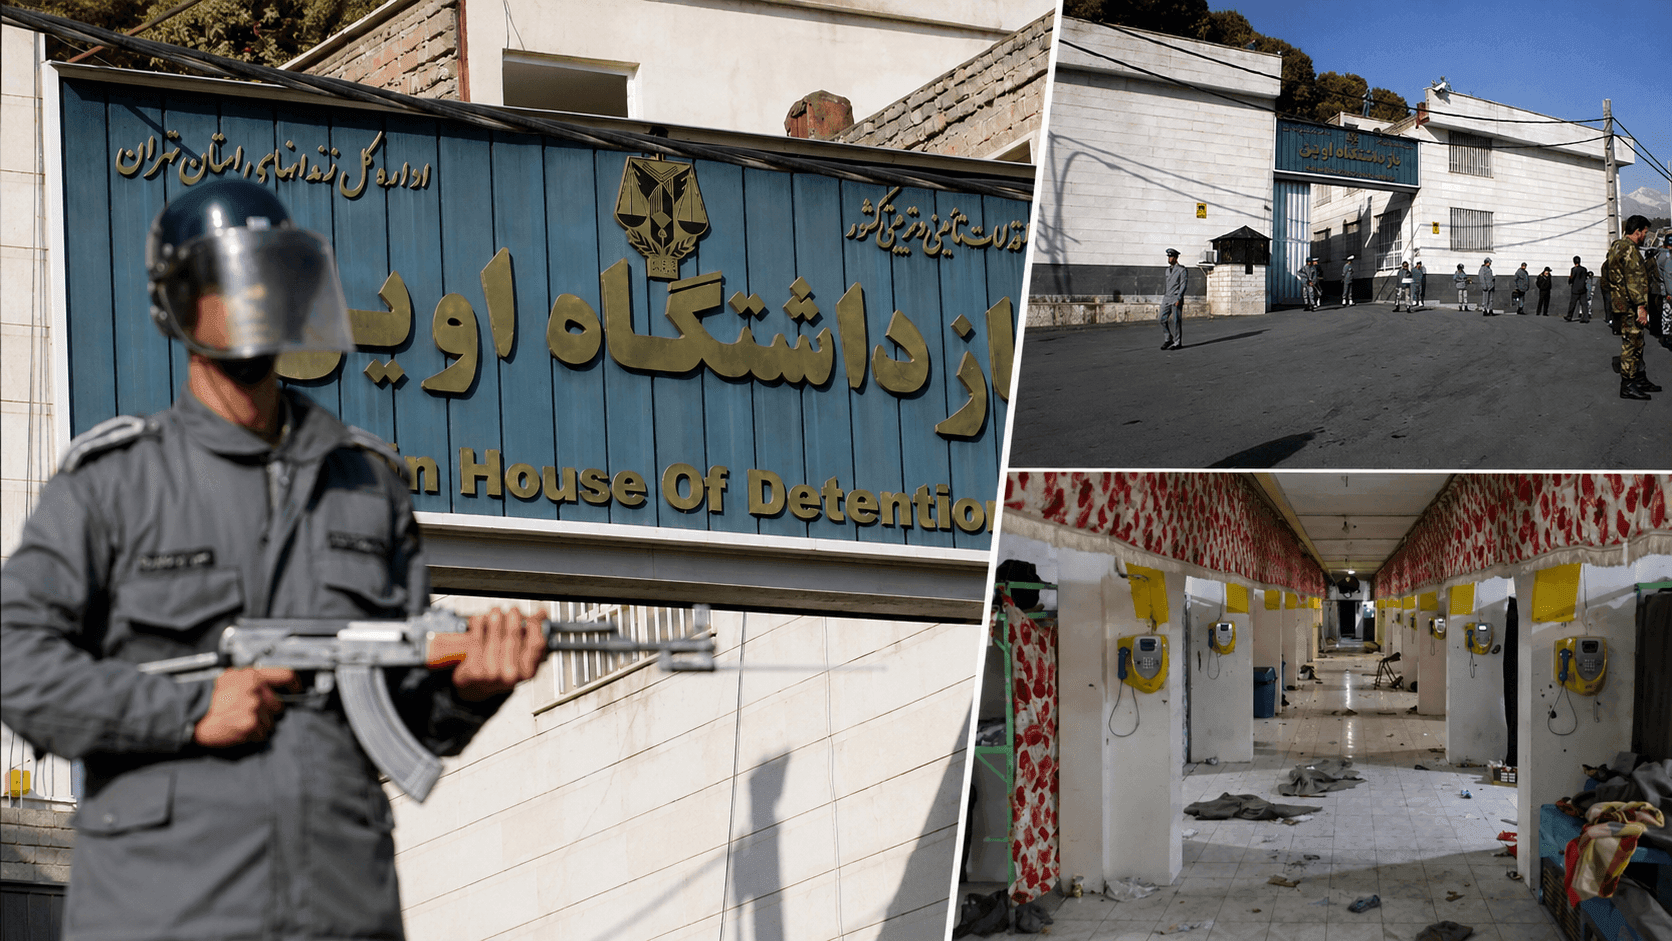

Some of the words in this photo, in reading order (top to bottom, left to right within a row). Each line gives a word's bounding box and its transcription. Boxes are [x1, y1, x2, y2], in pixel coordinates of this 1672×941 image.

[546, 257, 1013, 437] ازداشتگاه
[459, 446, 647, 506] House
[661, 462, 729, 513] Of
